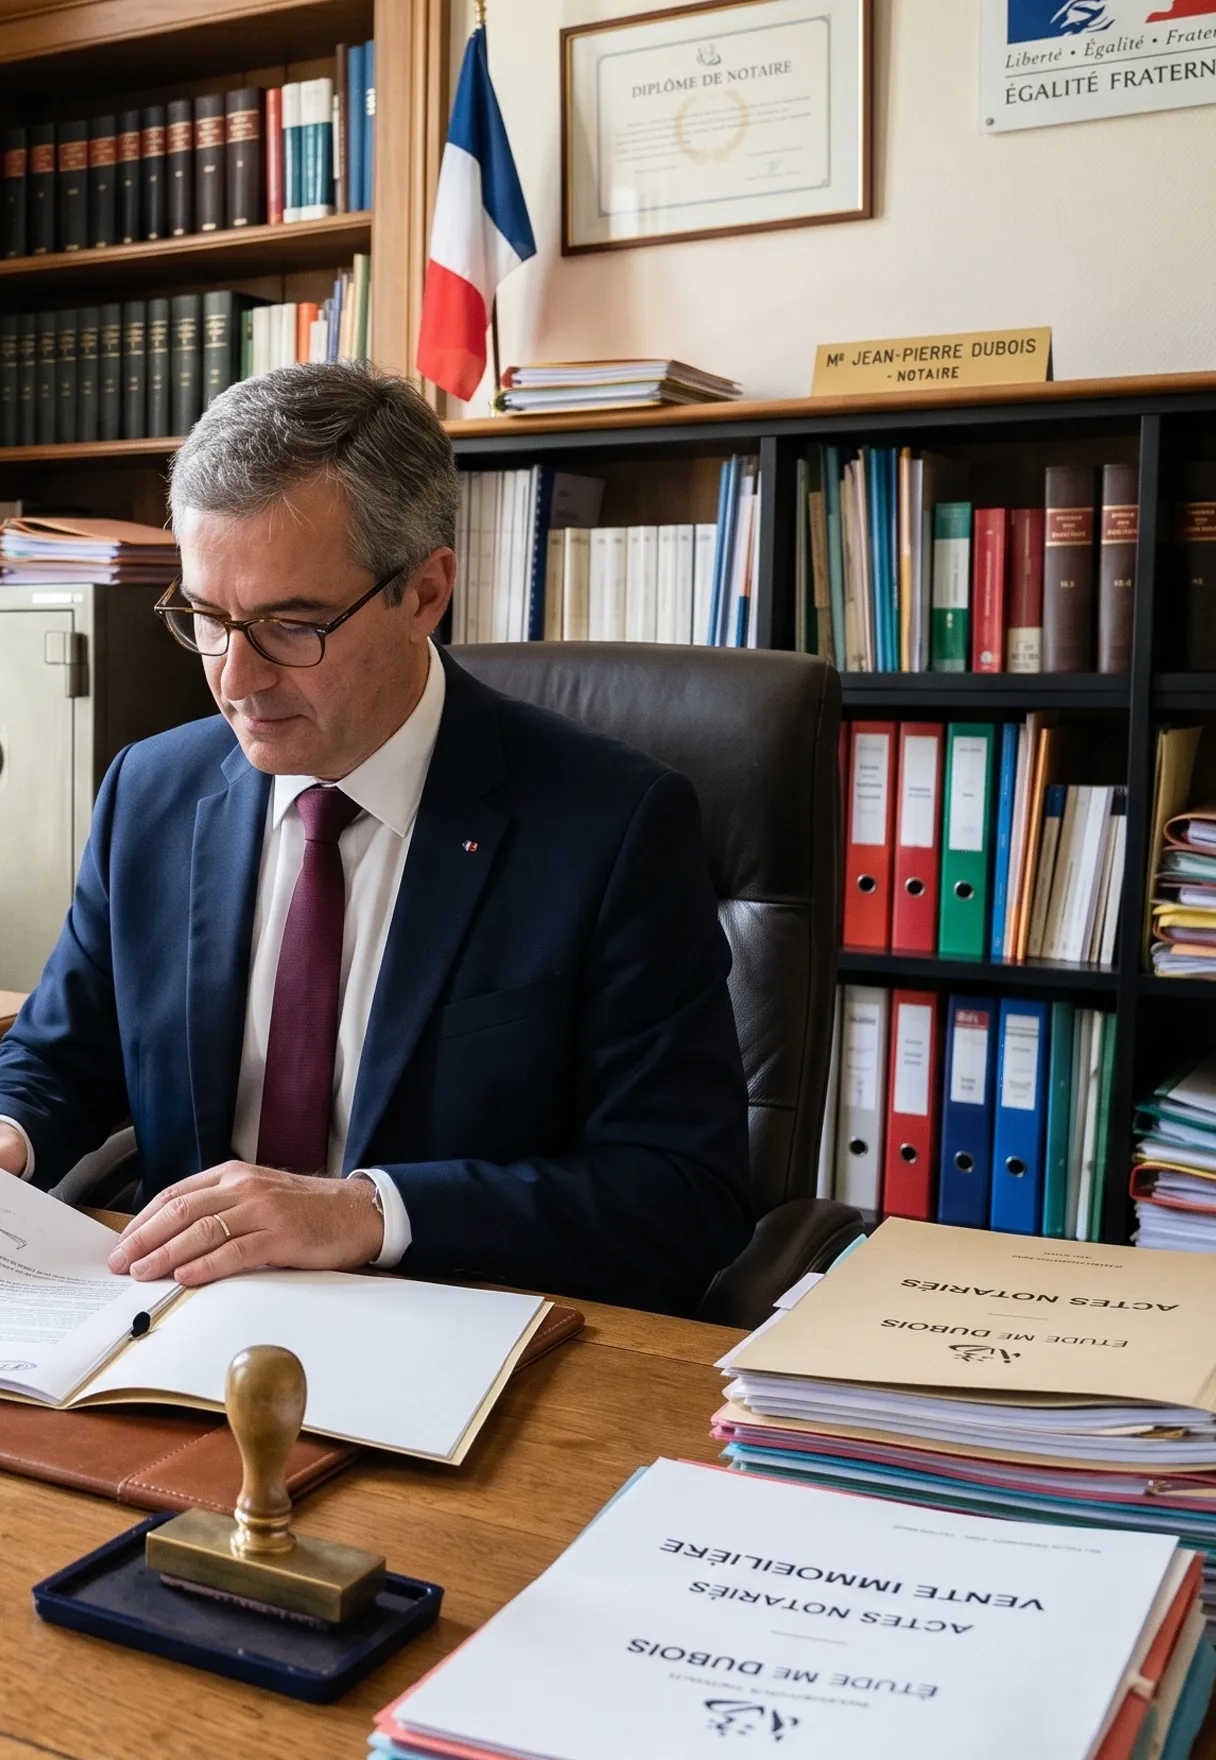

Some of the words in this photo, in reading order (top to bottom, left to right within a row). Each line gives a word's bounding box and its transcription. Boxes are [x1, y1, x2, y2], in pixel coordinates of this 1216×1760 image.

[1005, 48, 1063, 69] Liberté
[1084, 35, 1145, 59] Égalité
[632, 75, 698, 99] DIPLÔME
[702, 72, 723, 87] DE
[727, 60, 793, 83] NOTAIRE
[1005, 71, 1099, 105] ÉGALITÉ
[852, 343, 964, 366] JEAN-PIERRE
[971, 338, 1037, 358] DUBOIS
[897, 366, 960, 382] NOTAIRE
[901, 1278, 1059, 1304] NOTARIÉS
[1069, 1297, 1179, 1313] ACTES
[881, 1318, 992, 1338] DUBOIS
[997, 1332, 1036, 1342] ME
[689, 1581, 851, 1619] NOTARIÉS
[913, 1584, 1044, 1611] VENTE
[860, 1611, 974, 1634] ACTES
[626, 1638, 764, 1676] DUBOIS
[772, 1666, 819, 1683] ME
